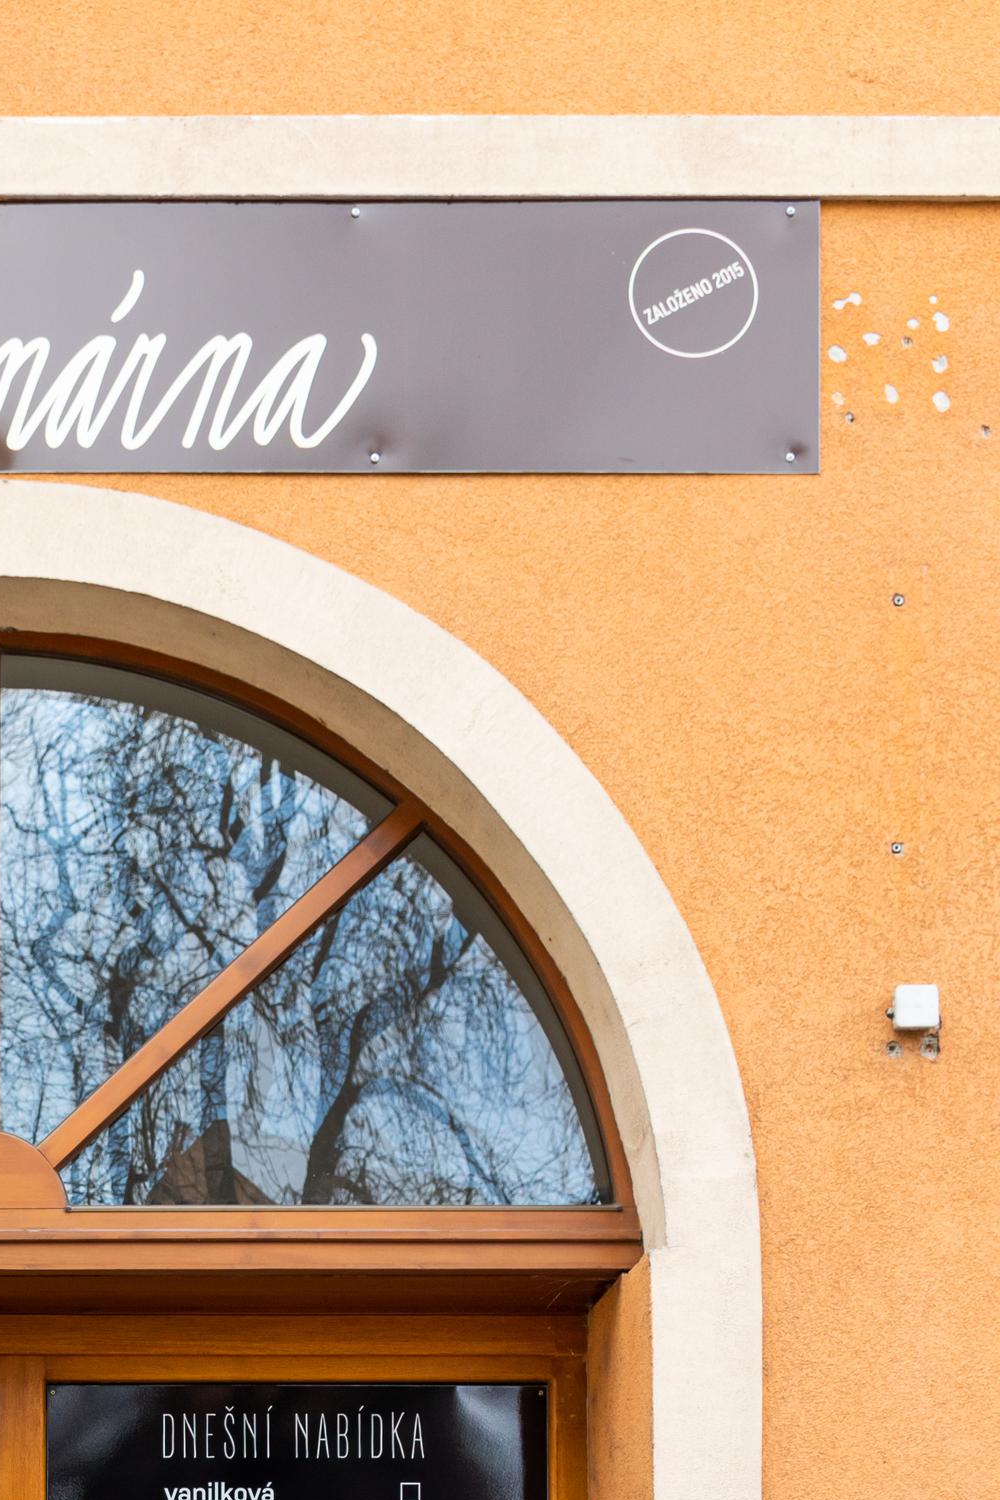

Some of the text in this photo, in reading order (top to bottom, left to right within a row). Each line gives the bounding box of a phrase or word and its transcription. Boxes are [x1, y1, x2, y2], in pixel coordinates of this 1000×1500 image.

[642, 261, 745, 325] ZALOŽENO 2015
[162, 1405, 425, 1460] DNEŠNÍ NABÍDKA
